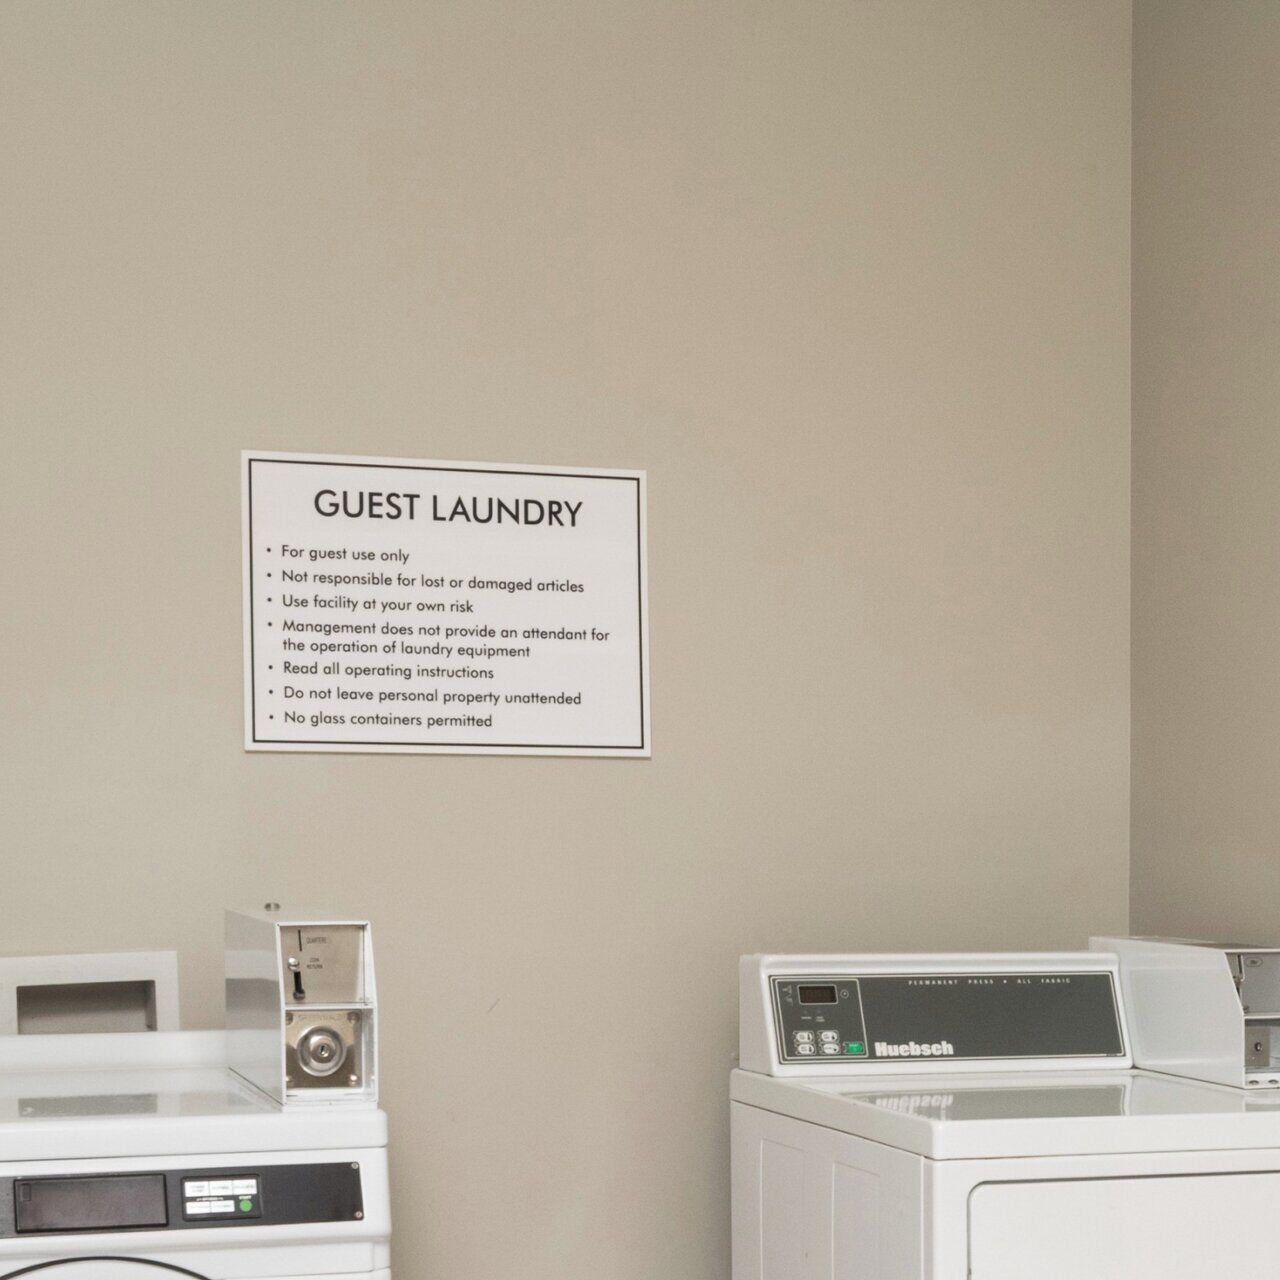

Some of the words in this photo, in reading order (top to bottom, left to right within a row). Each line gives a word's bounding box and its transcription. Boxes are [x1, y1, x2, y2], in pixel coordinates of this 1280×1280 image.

[314, 489, 420, 520] GUEST
[433, 495, 583, 527] LAUNDRY
[282, 545, 304, 558] For
[309, 548, 347, 561] guest
[352, 552, 375, 561] use
[380, 549, 409, 565] only
[282, 570, 308, 582] Not
[313, 572, 392, 587] responsible
[397, 573, 416, 586] for
[421, 574, 444, 587] lost
[449, 579, 464, 588] or
[468, 576, 532, 593] damaged
[537, 580, 584, 592] articles
[283, 594, 309, 607] Use
[313, 595, 358, 612] facility
[363, 599, 376, 609] at
[381, 602, 412, 613] your
[416, 602, 445, 612] own
[450, 600, 473, 613] risk
[283, 620, 376, 636] Management
[381, 622, 413, 635] does
[419, 625, 440, 636] not
[446, 625, 496, 639] provide
[501, 629, 517, 638] an
[523, 627, 587, 640] attendant
[591, 628, 610, 641] for
[283, 638, 305, 651] the
[310, 640, 377, 655] operation
[383, 641, 396, 653] of
[401, 641, 453, 658] laundry
[458, 644, 530, 659] equipment
[284, 661, 318, 674] Read
[323, 662, 339, 675] all
[345, 664, 412, 680] operating
[417, 664, 494, 679] instructions
[284, 686, 304, 699] Do
[310, 688, 331, 699] not
[337, 687, 374, 700] leave
[379, 689, 438, 703] personal
[443, 692, 500, 706] property
[505, 692, 581, 705] unattended
[285, 711, 305, 723] No
[311, 711, 345, 727] glass
[350, 713, 422, 726] containers
[427, 714, 492, 729] permitted
[875, 1041, 954, 1056] Huebsch
